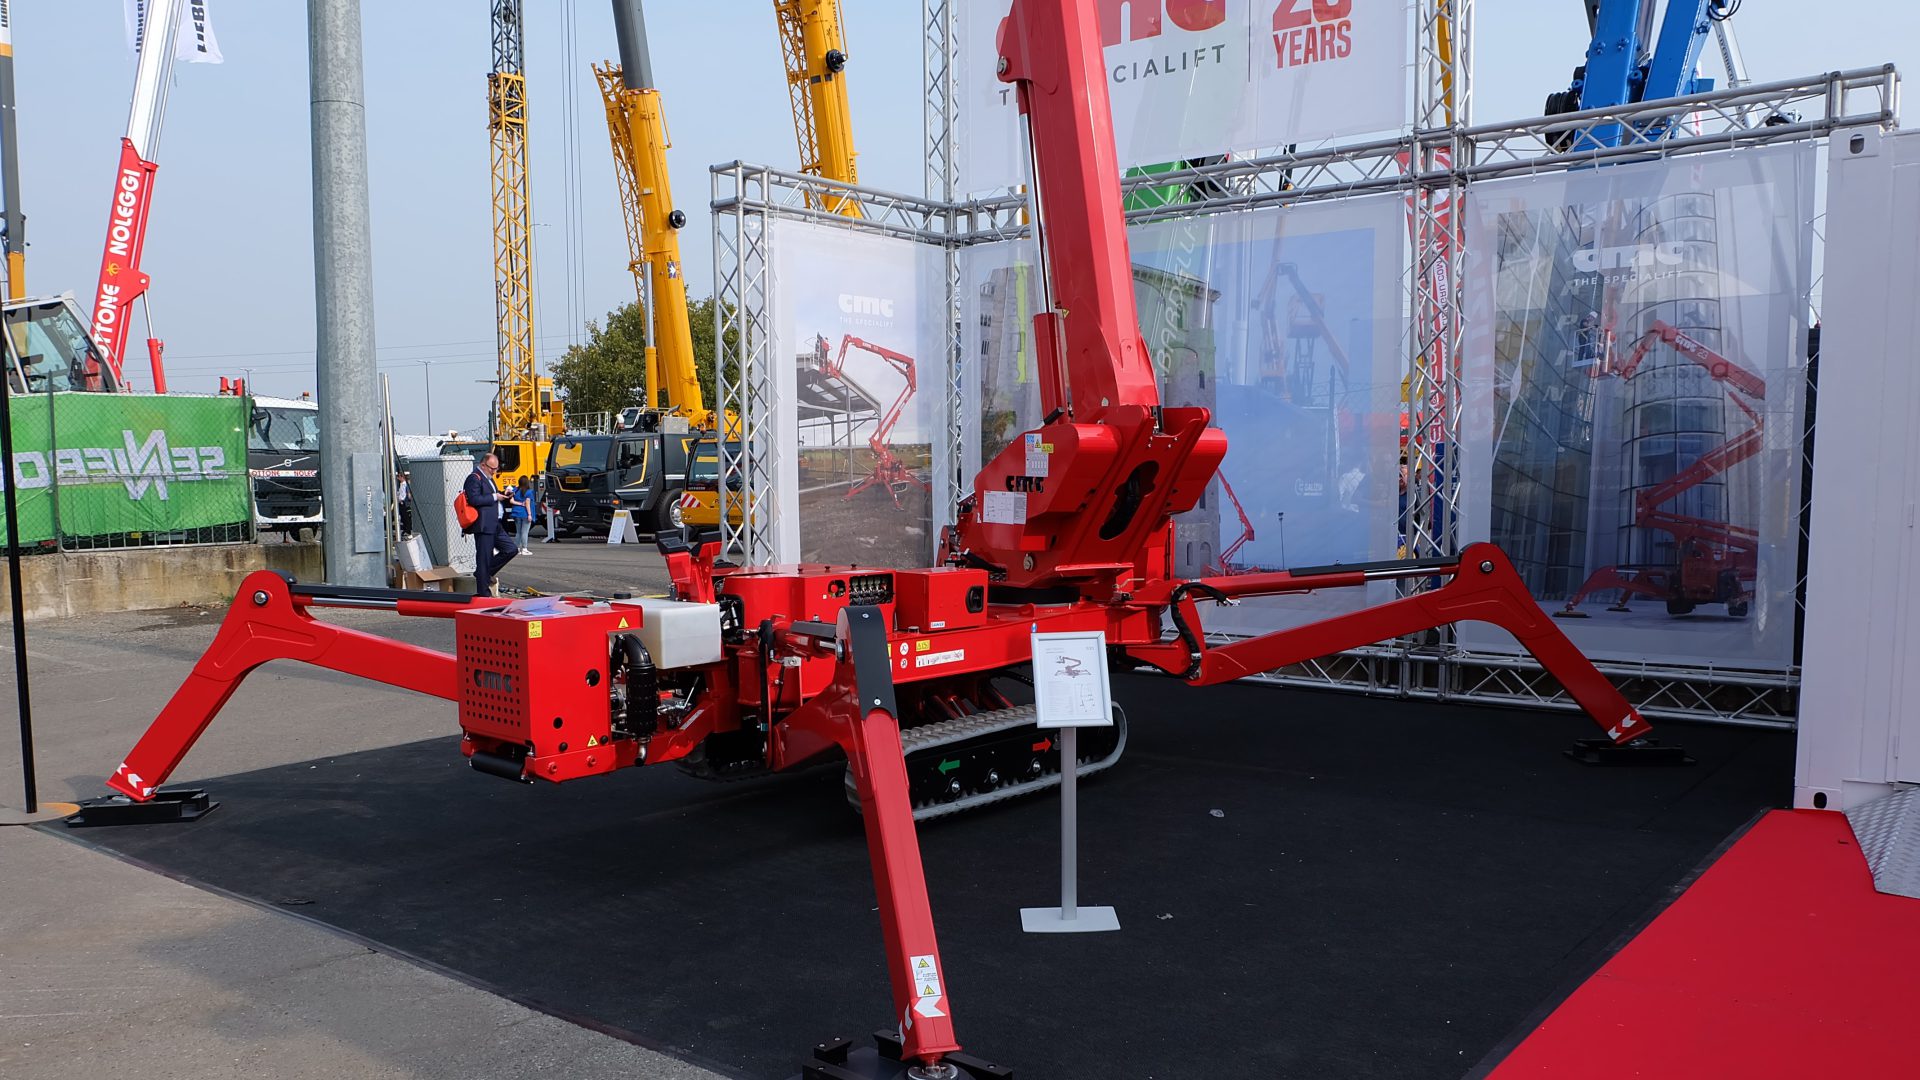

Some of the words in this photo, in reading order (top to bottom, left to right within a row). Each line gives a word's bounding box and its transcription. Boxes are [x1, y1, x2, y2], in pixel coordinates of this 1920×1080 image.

[1113, 43, 1226, 84] CIALIFT
[1273, 20, 1352, 69] YEARS
[109, 168, 142, 257] NOLEGGI
[1573, 276, 1598, 288] THE
[1603, 269, 1683, 286] SPECIALIFT
